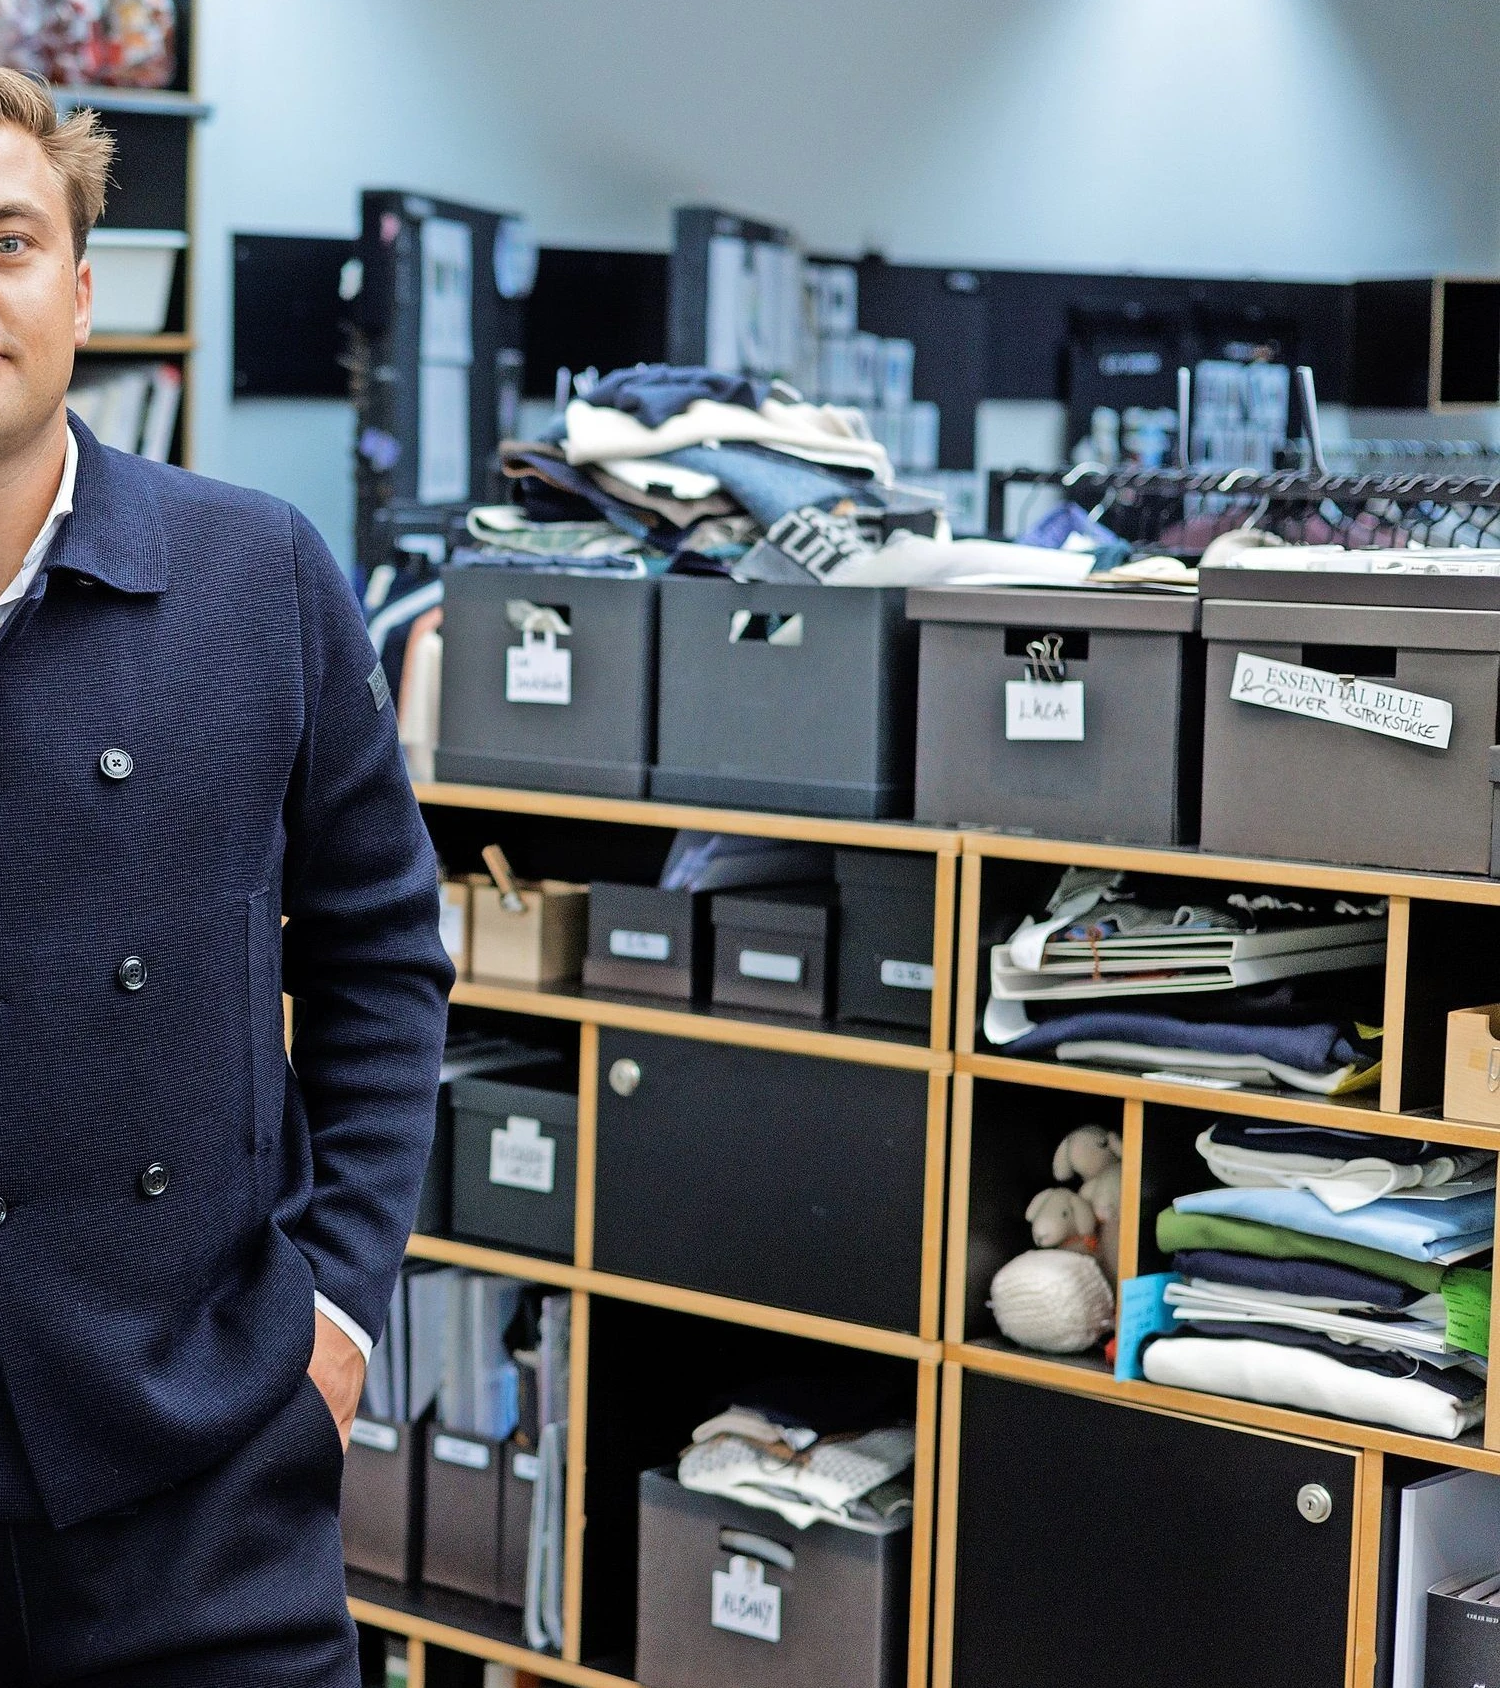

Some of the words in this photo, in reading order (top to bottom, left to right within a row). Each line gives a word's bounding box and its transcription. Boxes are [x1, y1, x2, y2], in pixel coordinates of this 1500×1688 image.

[1263, 688, 1329, 715] OLIVER
[1267, 667, 1368, 705] ESSENTIAL
[1375, 692, 1424, 718] BLUE
